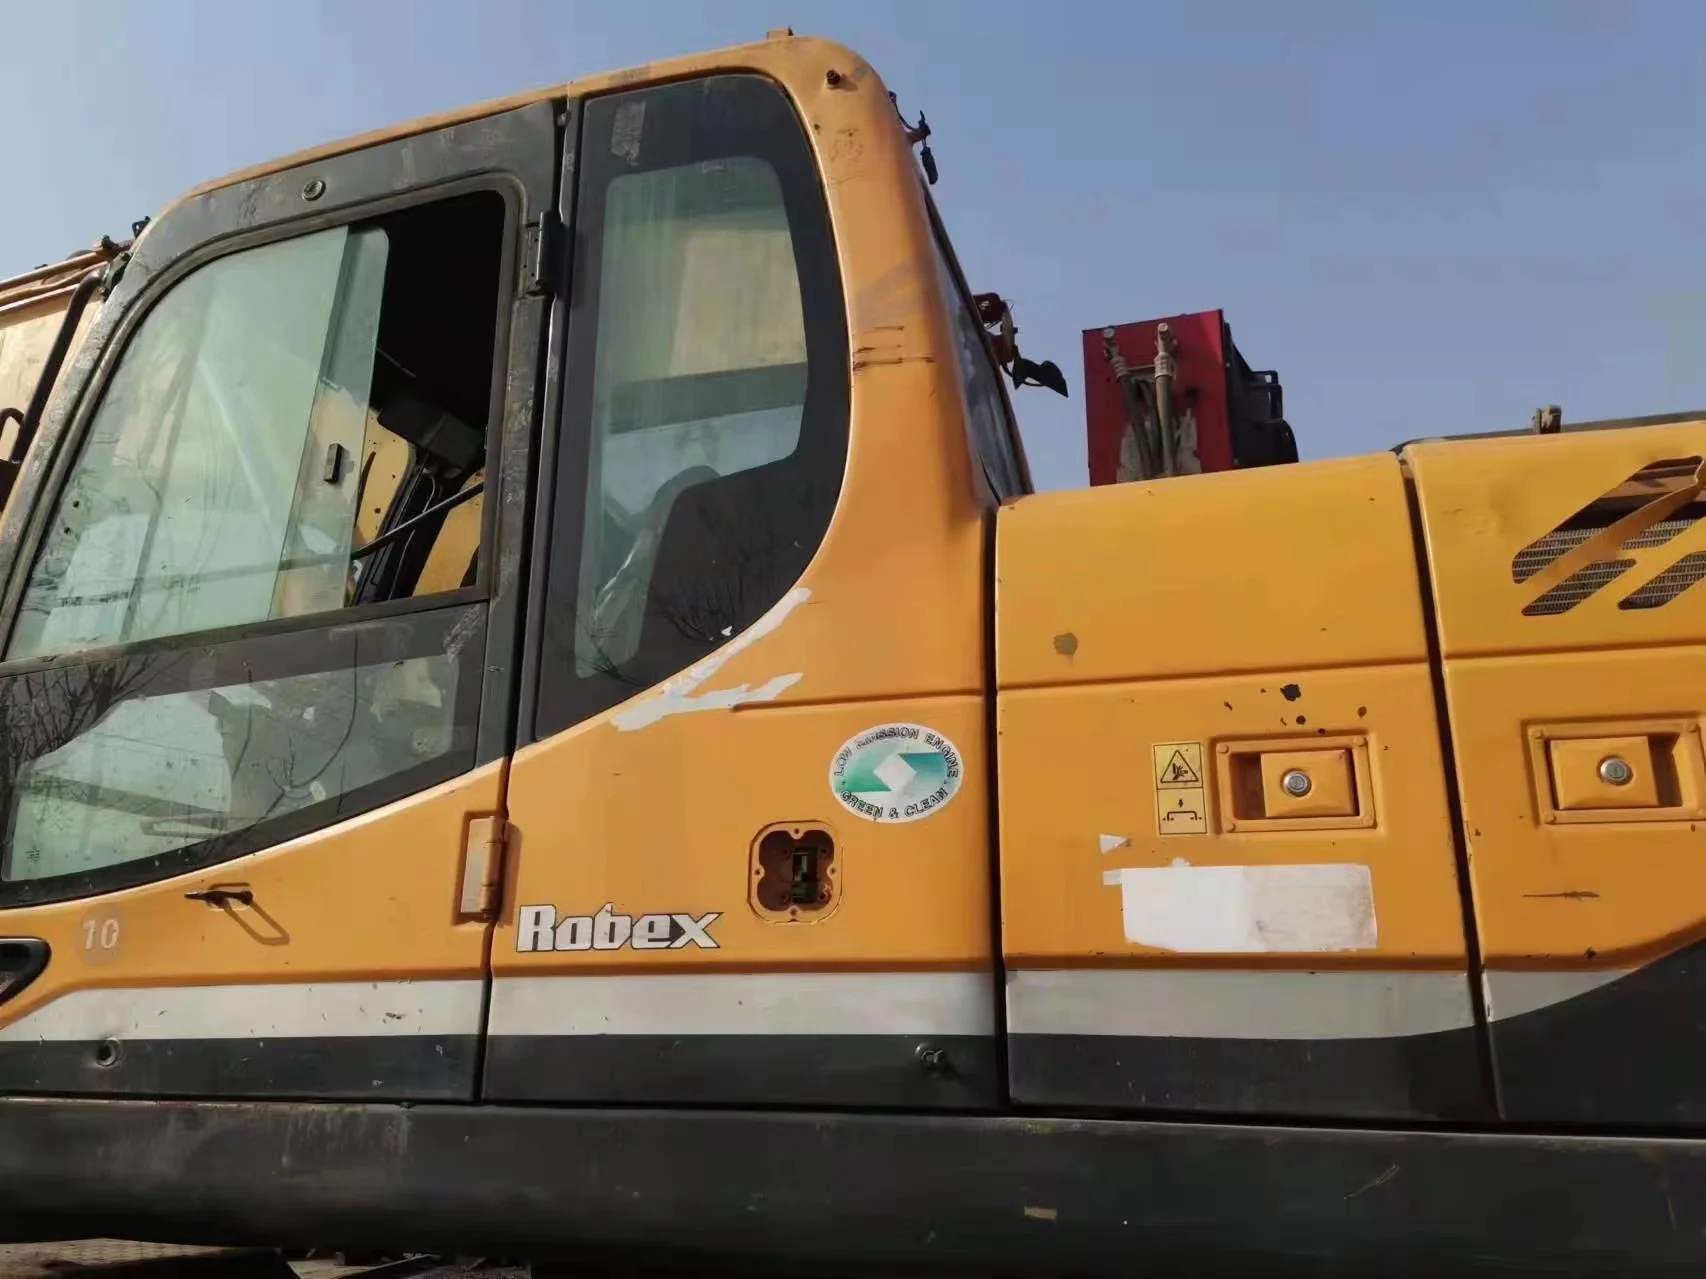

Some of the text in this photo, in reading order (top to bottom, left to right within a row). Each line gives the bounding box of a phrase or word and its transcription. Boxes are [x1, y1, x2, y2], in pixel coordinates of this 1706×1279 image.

[833, 747, 853, 777] LOW
[924, 732, 960, 779] ENGINE
[840, 787, 949, 819] GREEN & CLEAN
[82, 918, 120, 949] 10
[516, 902, 724, 952] Robex
